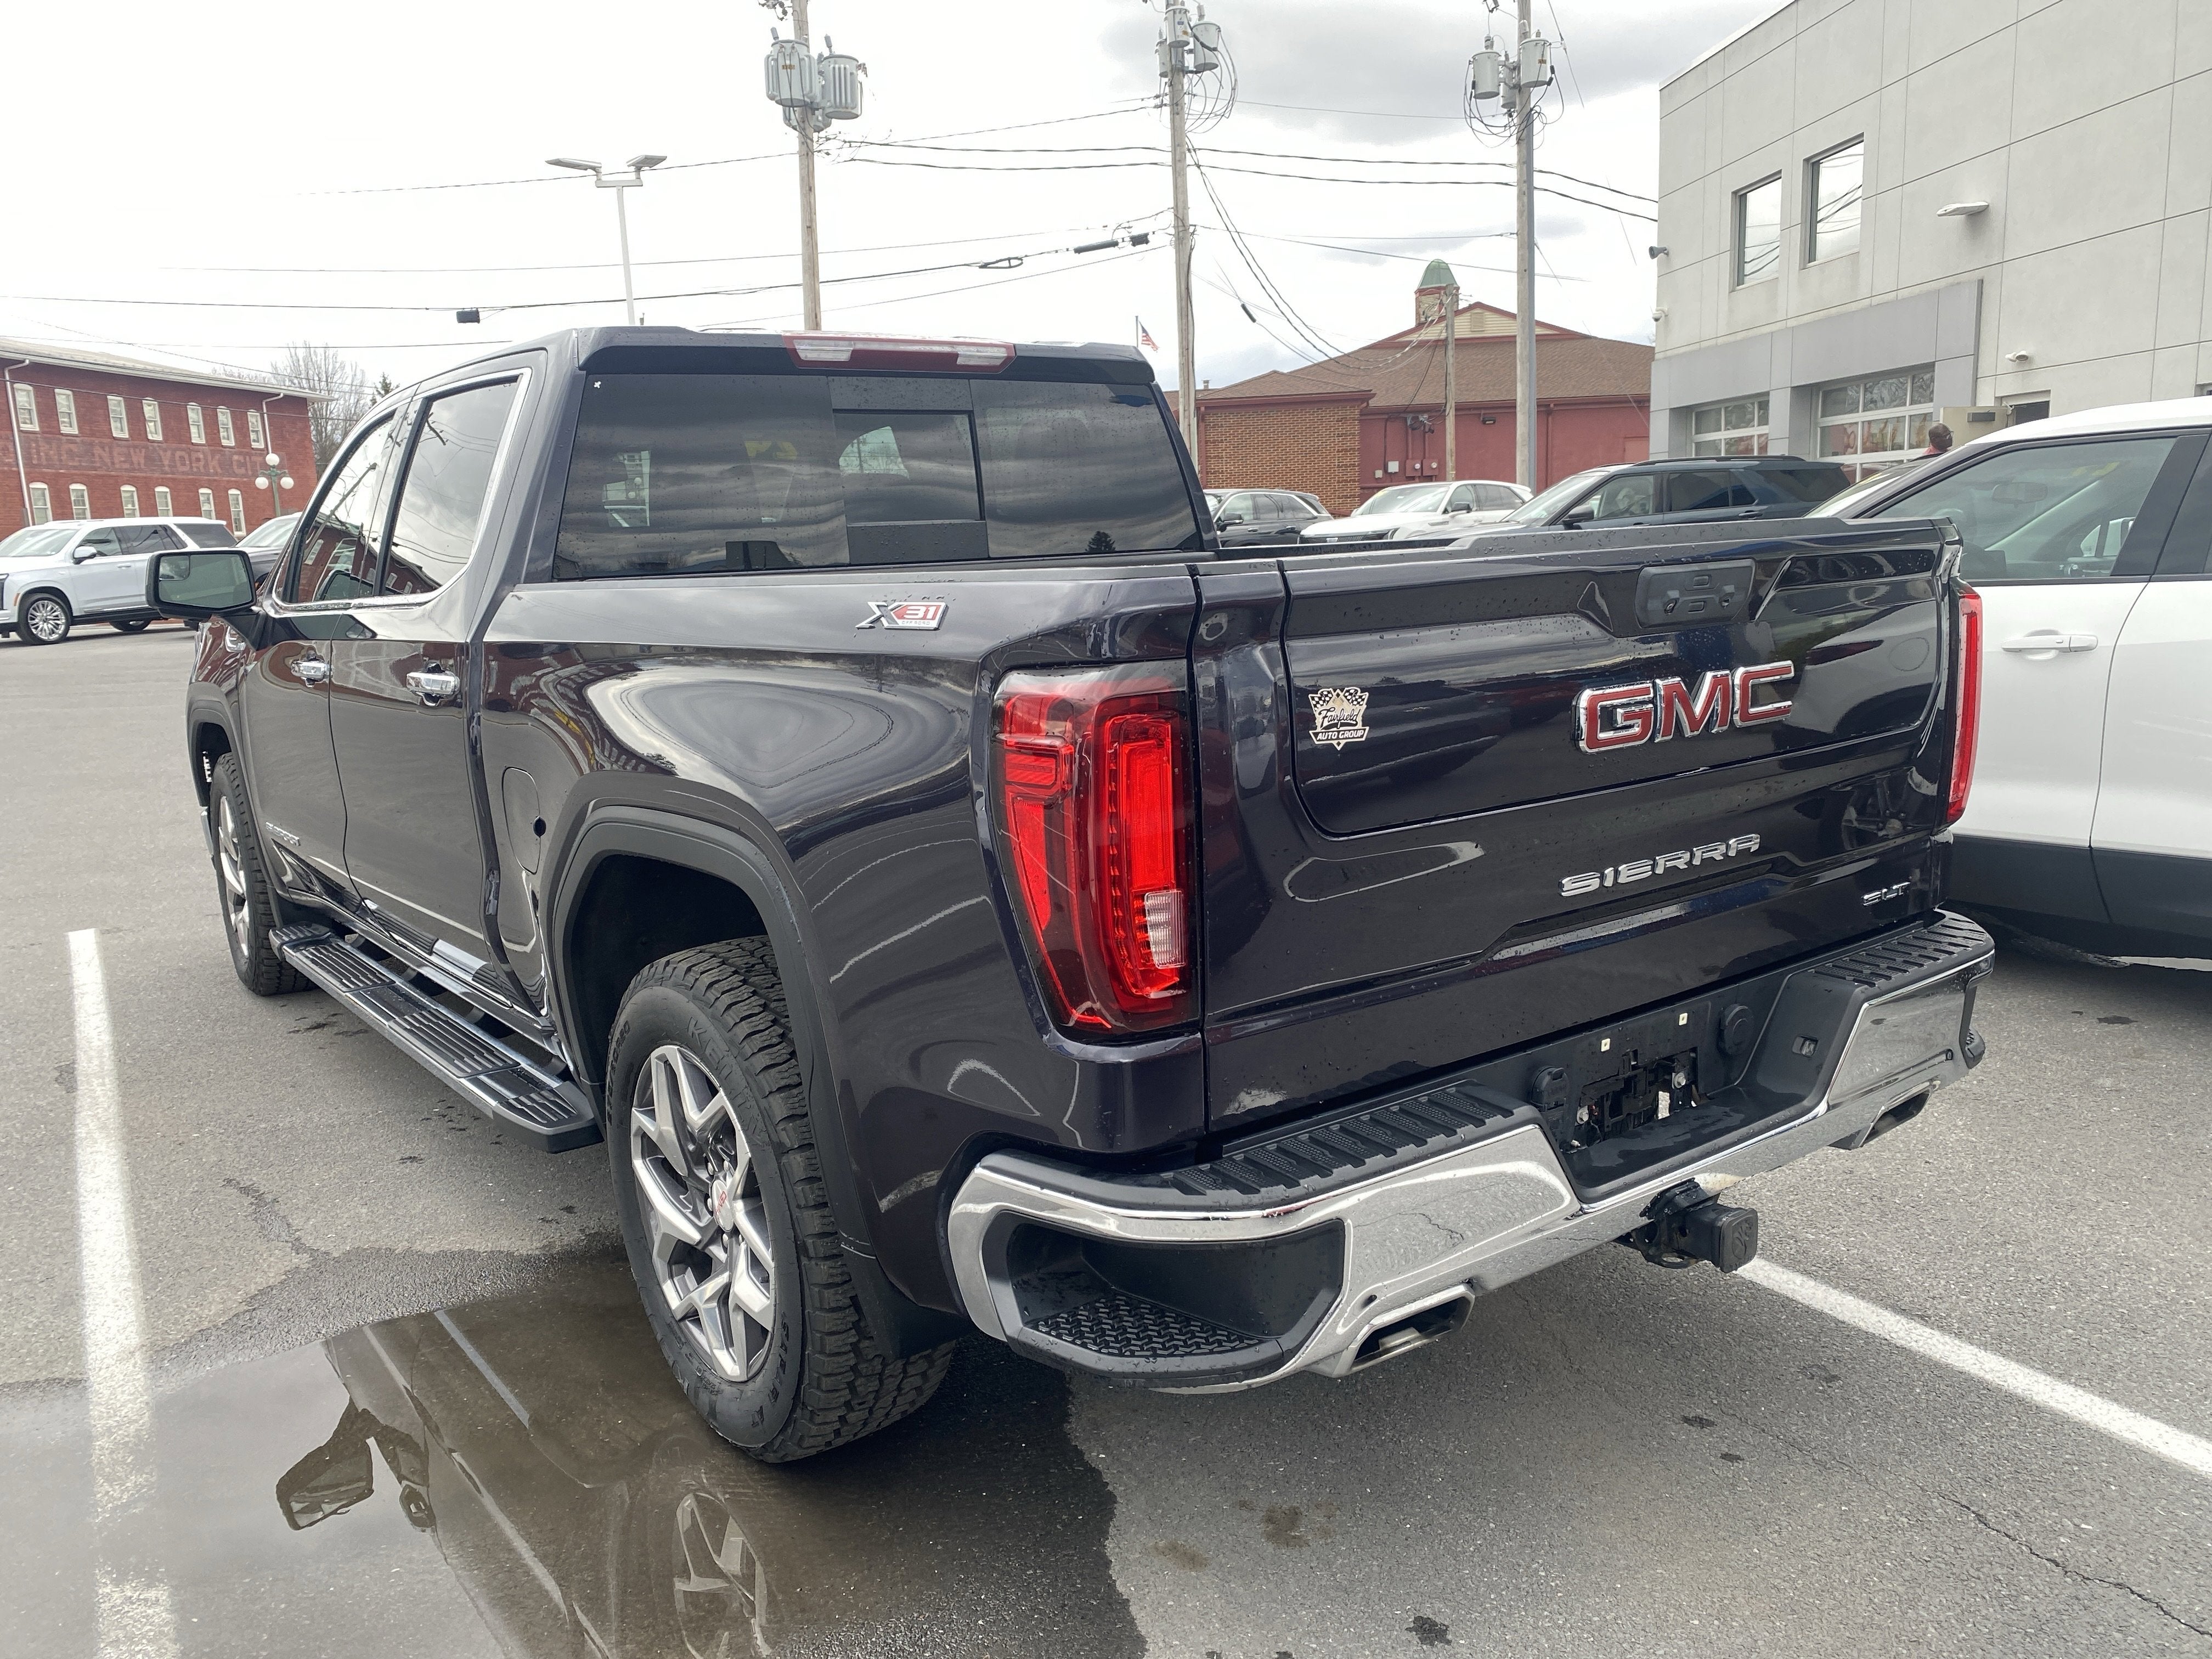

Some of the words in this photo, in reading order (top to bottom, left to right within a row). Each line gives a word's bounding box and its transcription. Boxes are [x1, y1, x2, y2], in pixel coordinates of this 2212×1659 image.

[93, 444, 145, 468] NEW
[159, 449, 223, 473] YORK
[232, 454, 273, 475] CIT
[855, 601, 949, 630] X31
[1318, 707, 1361, 729] Fairfield
[1575, 660, 1795, 753] GMC
[1317, 732, 1337, 740] AUTO
[1339, 730, 1364, 739] GROUP
[1559, 833, 1760, 897] SIERRA
[1863, 882, 1911, 906] SLT
